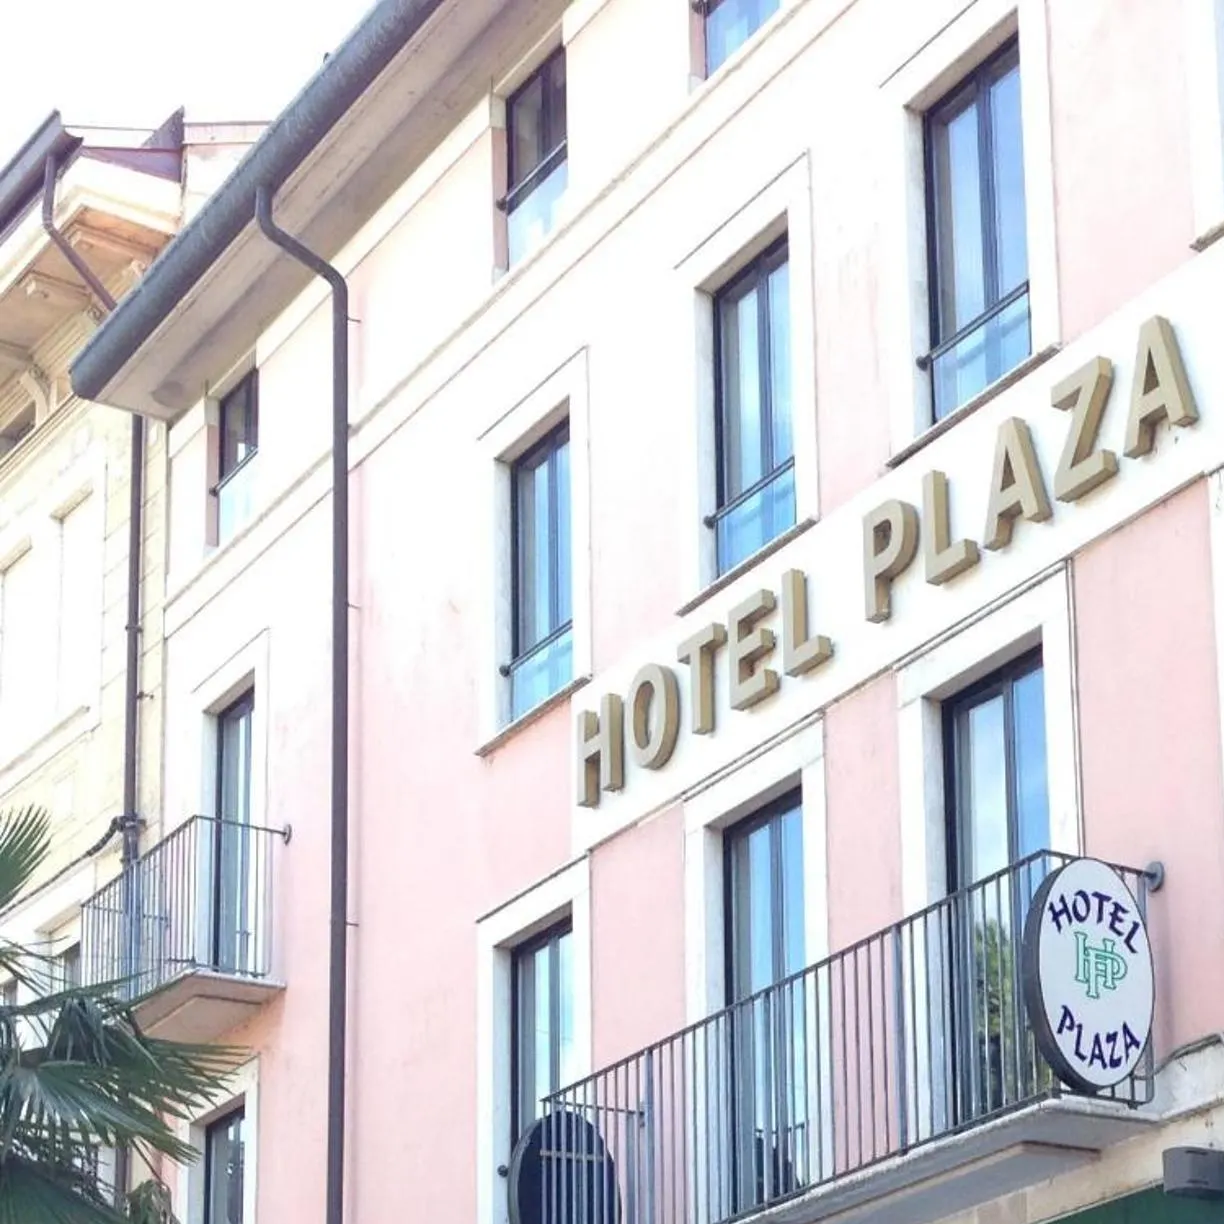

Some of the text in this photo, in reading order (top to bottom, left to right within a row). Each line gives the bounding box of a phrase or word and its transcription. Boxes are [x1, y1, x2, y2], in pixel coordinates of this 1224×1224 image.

[576, 315, 1200, 808] HOTEL PLAZA
[1048, 889, 1141, 954] HOTEL
[1056, 1004, 1141, 1071] PLAZA
